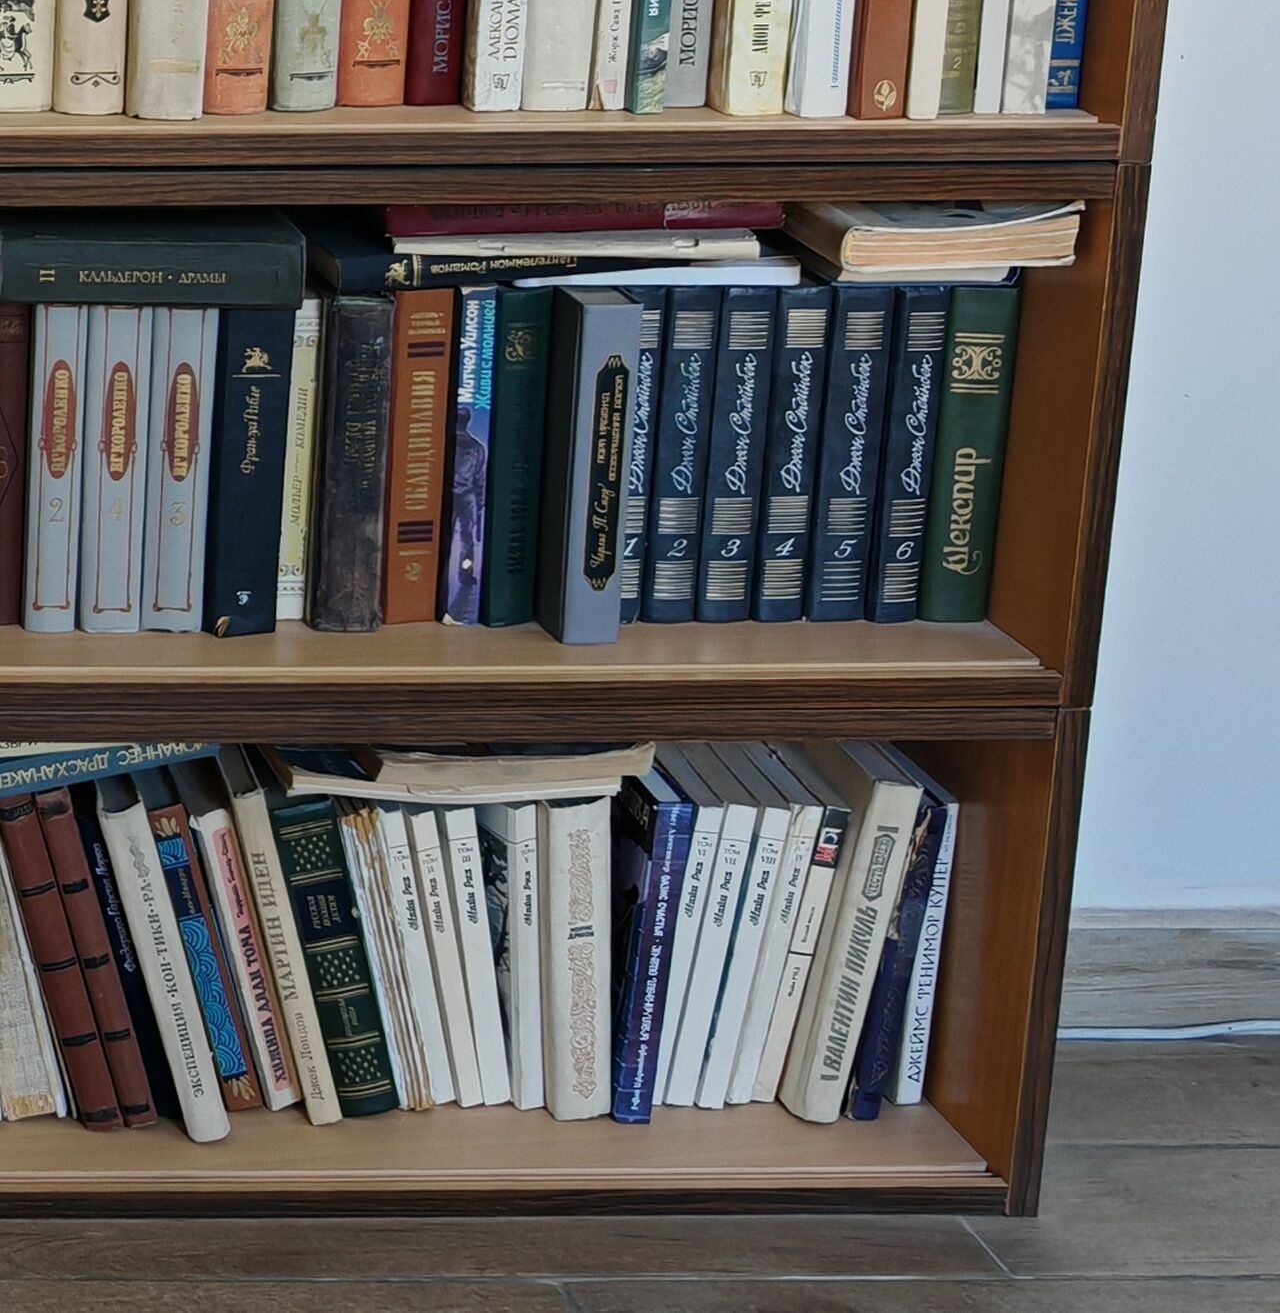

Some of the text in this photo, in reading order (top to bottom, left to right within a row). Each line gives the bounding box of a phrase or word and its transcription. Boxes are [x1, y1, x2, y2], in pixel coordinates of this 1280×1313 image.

[431, 0, 454, 74] МОРИС
[78, 269, 164, 286] КАЛЬДЕРОН
[430, 260, 487, 275] Романов
[458, 300, 479, 403] Митчел Уилсон
[475, 299, 497, 409] Живи молнией
[52, 368, 70, 451] КОРОЛЕНКО
[110, 371, 128, 452] КОРОЛЕНКО
[174, 373, 192, 458] КОРОЛЕНКО
[403, 370, 436, 511] СКАНДИНАВИЯ
[665, 539, 689, 558] 2
[720, 537, 743, 558] 3
[774, 536, 798, 558] 4
[834, 539, 859, 560] 5
[894, 540, 915, 560] 6
[942, 446, 991, 576] Шекспир
[237, 925, 262, 967] ТОМА
[249, 850, 326, 1102] Джек Лондон МАРТИН ИДЕН
[905, 857, 948, 1084] ДЖЕЙМС ФЕНИМОР КУПЕР
[821, 905, 878, 1072] ВАЛЕНТИН ПИКУЛЬ
[170, 1002, 206, 1098] ЭКСПЕДИЦИЯ
